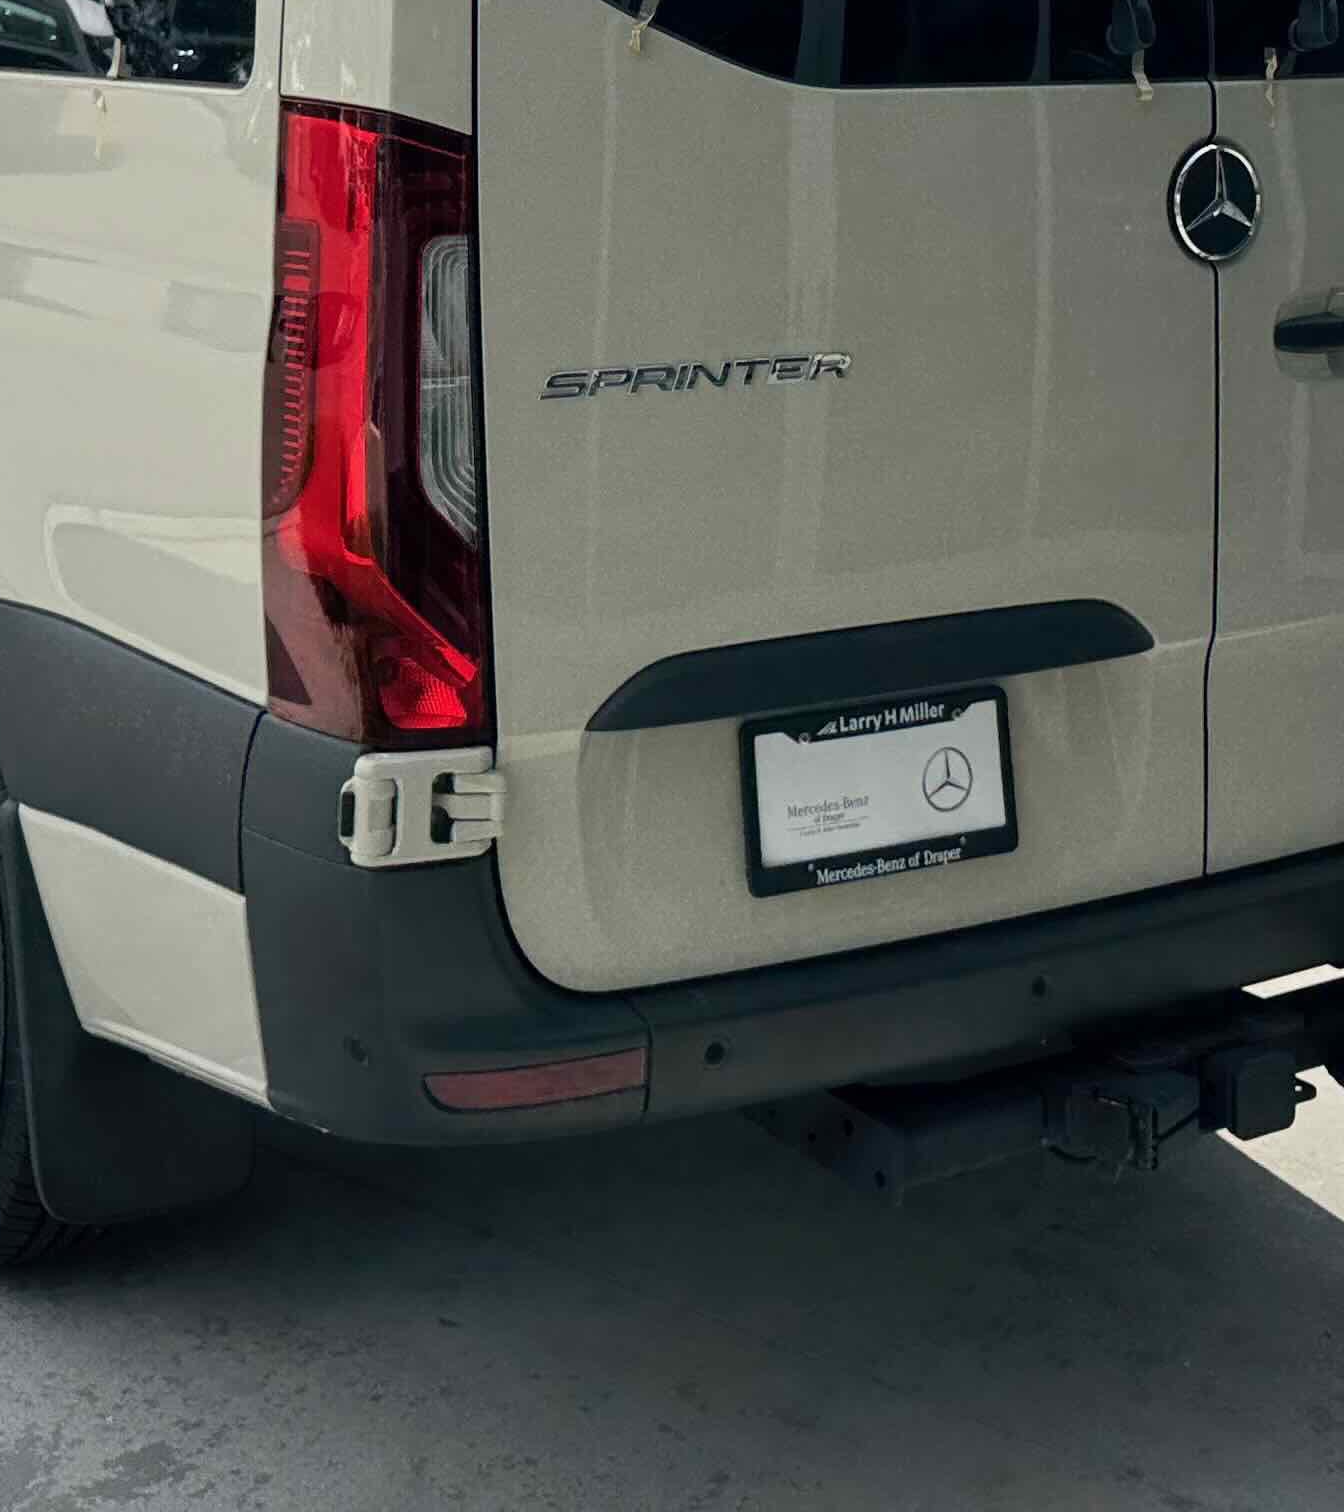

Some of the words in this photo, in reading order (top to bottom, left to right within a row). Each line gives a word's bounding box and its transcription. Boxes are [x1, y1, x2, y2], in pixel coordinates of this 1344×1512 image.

[537, 351, 853, 401] SPRINTER
[839, 714, 882, 732] Larry
[884, 708, 897, 726] H
[899, 701, 945, 724] Miller
[816, 856, 906, 885] Mercedes-Benz
[908, 851, 921, 868] of
[924, 847, 961, 865] Draper
